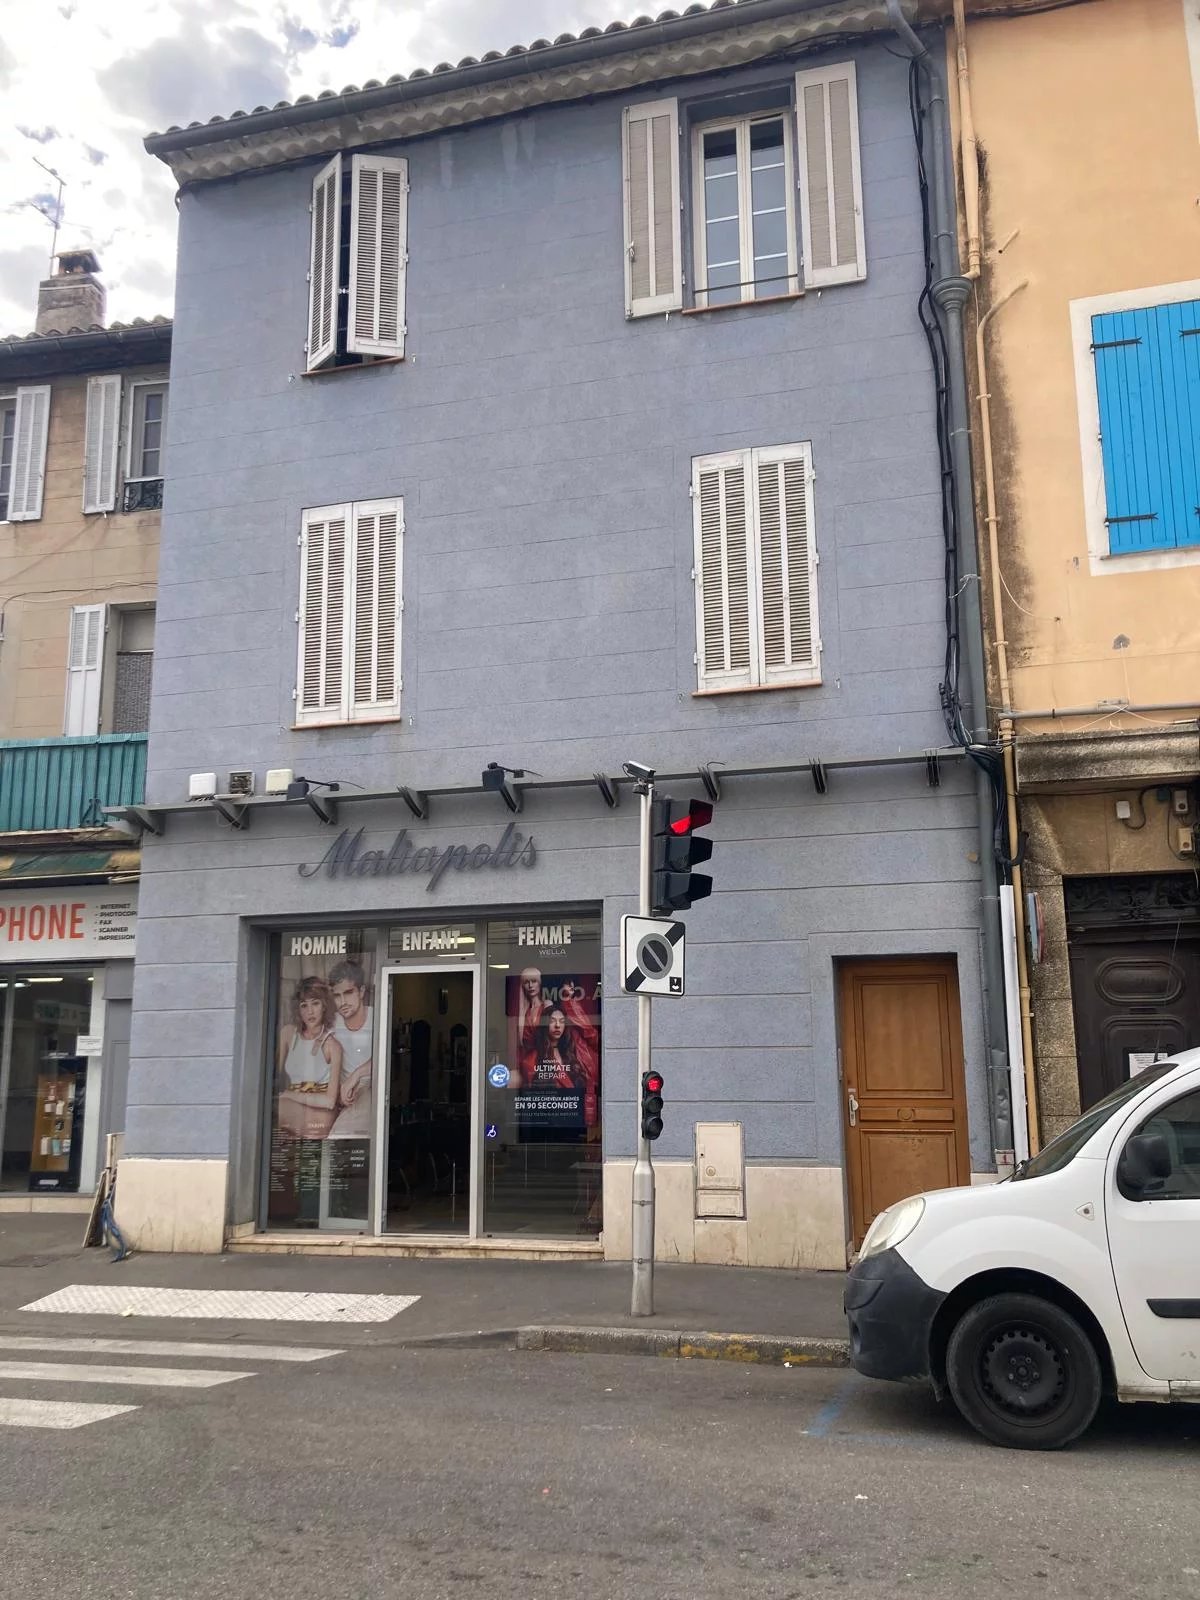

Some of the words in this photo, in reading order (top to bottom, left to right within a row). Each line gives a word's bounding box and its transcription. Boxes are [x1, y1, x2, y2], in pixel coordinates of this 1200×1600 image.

[297, 821, 537, 892] Maliapolis
[402, 930, 461, 951] ENFANT
[518, 925, 572, 946] FEMME
[291, 935, 348, 957] HOMME
[539, 948, 567, 956] WELLA
[533, 1064, 571, 1072] ULTIMATE
[538, 1072, 567, 1080] REPAIR
[515, 1102, 526, 1110] EN
[527, 1102, 537, 1110] 90
[537, 1101, 578, 1109] SECONDES
